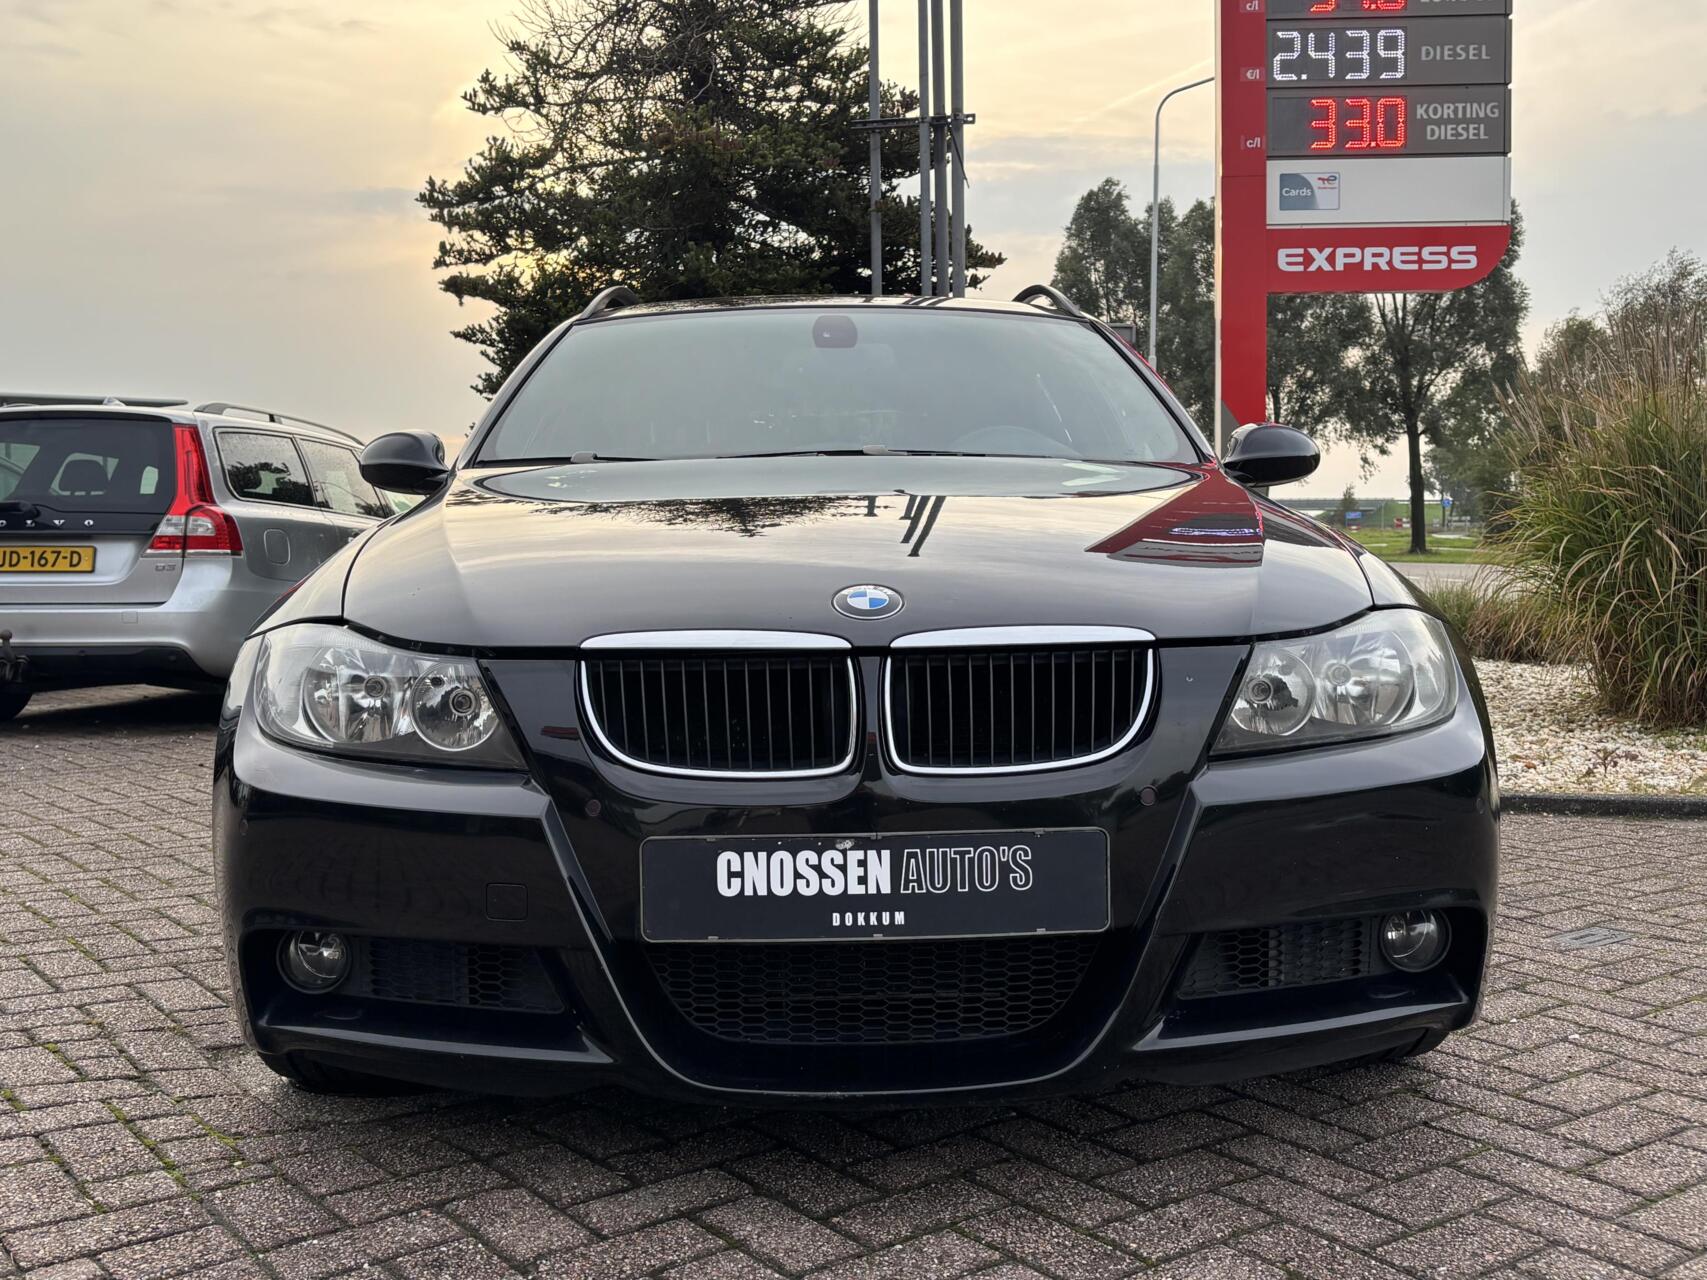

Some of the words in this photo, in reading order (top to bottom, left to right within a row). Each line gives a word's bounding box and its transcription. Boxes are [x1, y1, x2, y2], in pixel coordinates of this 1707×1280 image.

[1273, 29, 1405, 80] 2.439
[1421, 44, 1491, 61] DIESEL
[1416, 102, 1500, 119] KORTING
[1310, 97, 1405, 149] 33.0
[1426, 123, 1489, 140] DIESEL
[1282, 187, 1312, 197] Cards
[1277, 245, 1478, 272] EXPRESS
[716, 849, 892, 898] CNOSSEN
[900, 845, 1034, 894] AUTO'S
[832, 911, 906, 927] DOKKUM
